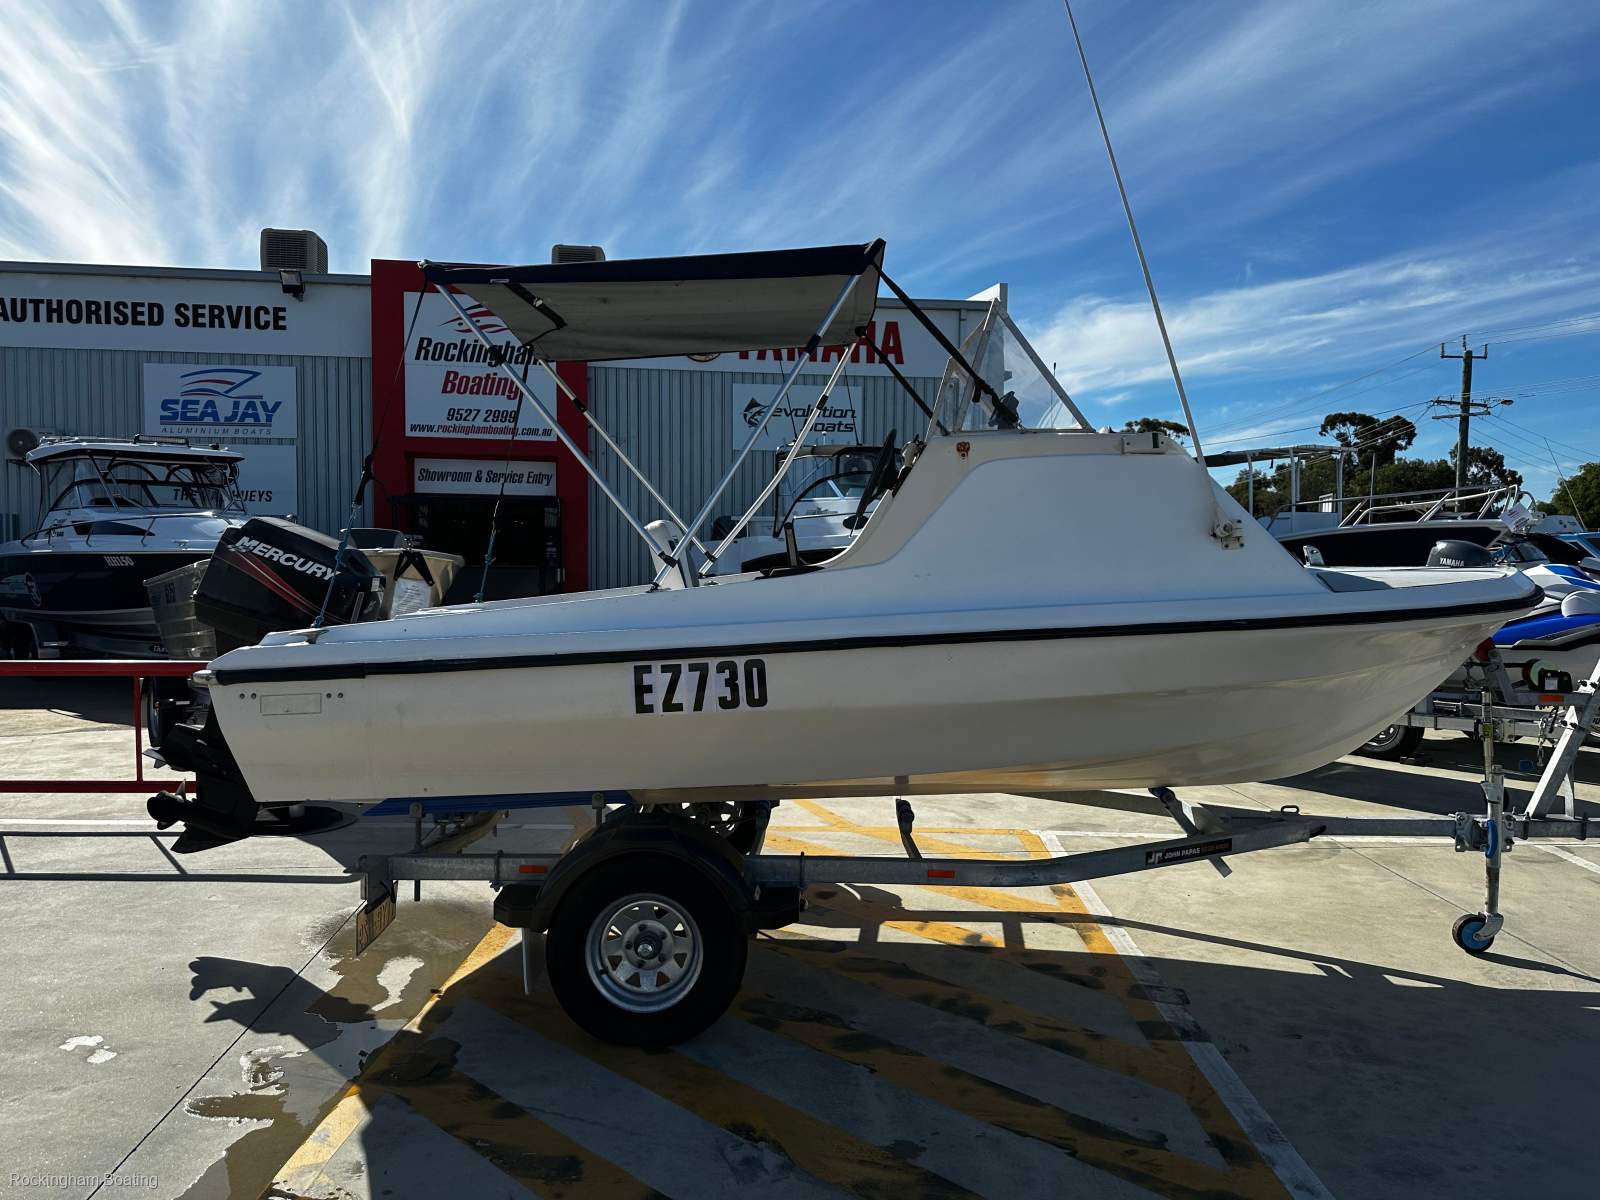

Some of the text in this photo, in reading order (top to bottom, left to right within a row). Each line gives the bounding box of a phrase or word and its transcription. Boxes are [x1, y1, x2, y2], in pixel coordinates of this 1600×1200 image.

[0, 297, 287, 331] AUTHORISED SERVICE
[441, 370, 521, 400] Boating
[446, 408, 517, 424] 9527 2999
[418, 467, 553, 486] Showroom & Service Entry
[235, 536, 341, 581] MERCURY
[1439, 557, 1465, 567] YAMAHA
[633, 658, 768, 714] EZ730
